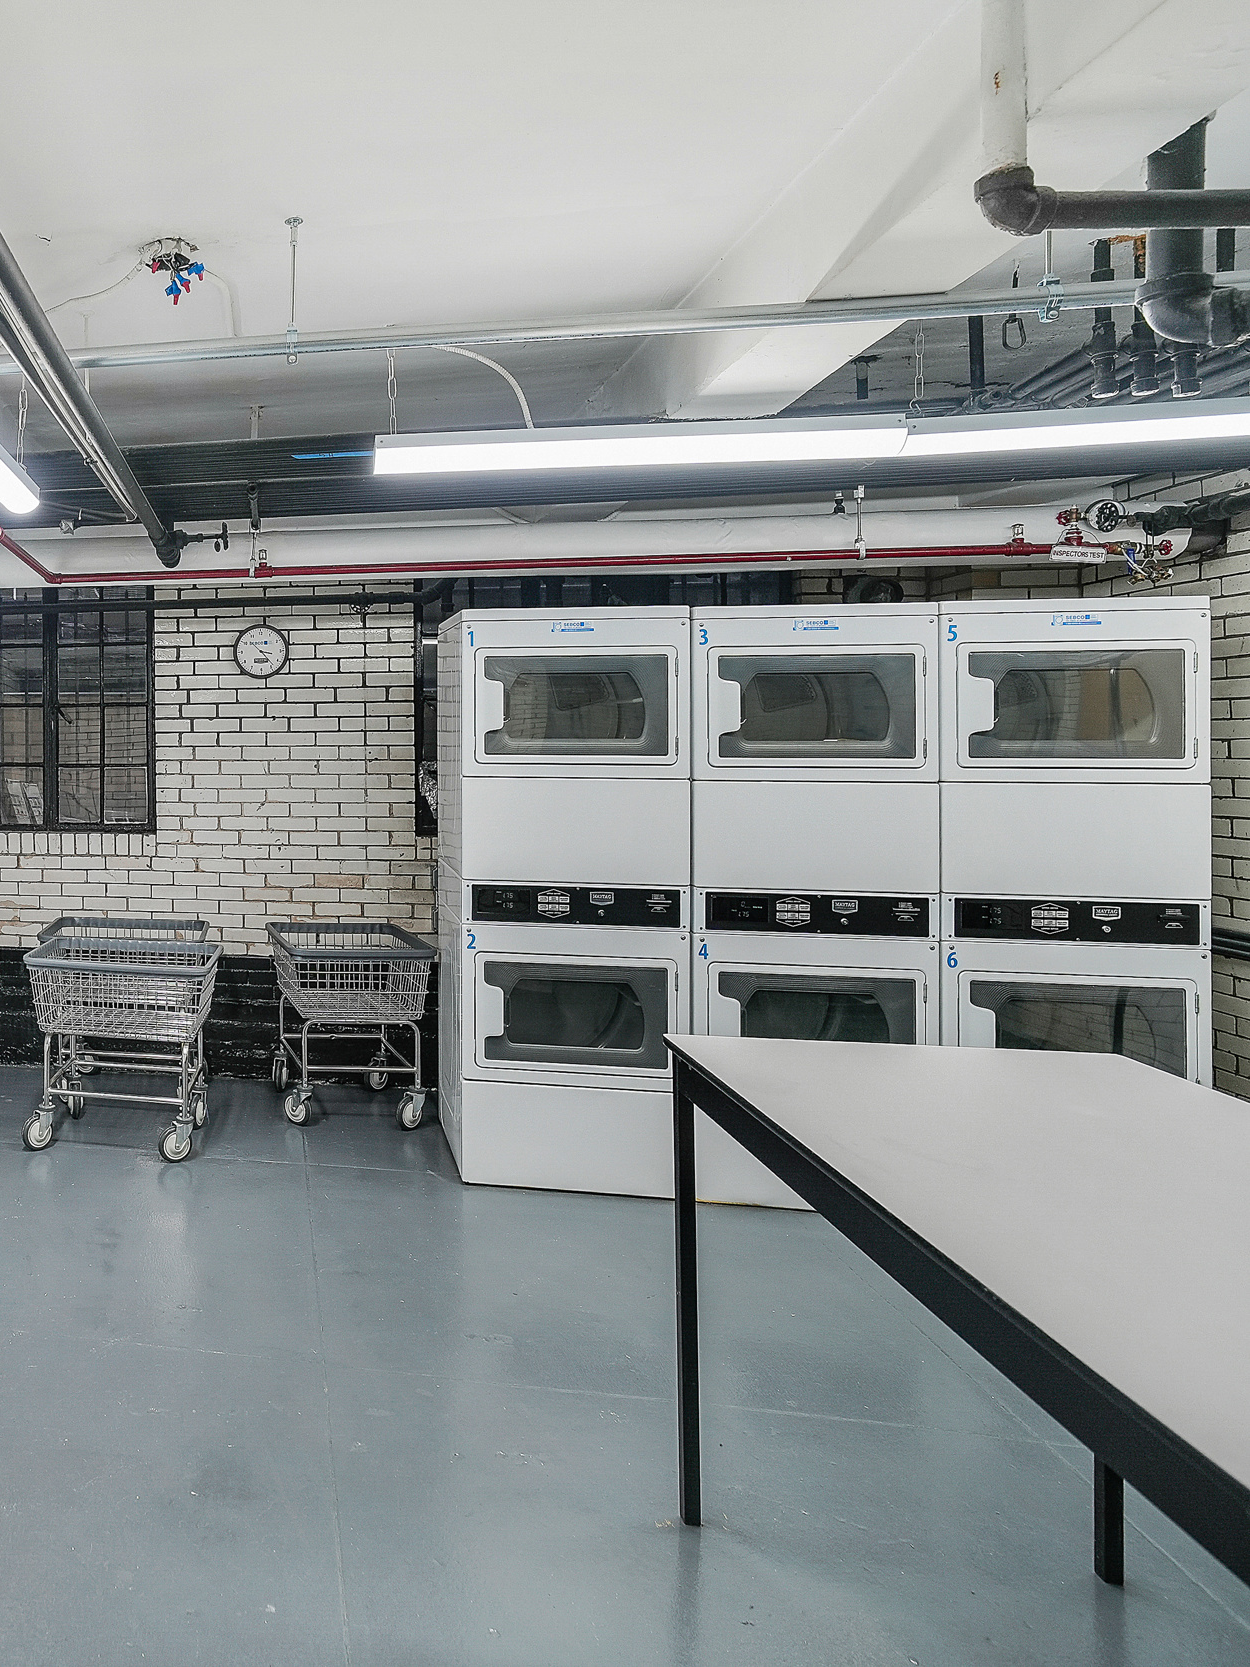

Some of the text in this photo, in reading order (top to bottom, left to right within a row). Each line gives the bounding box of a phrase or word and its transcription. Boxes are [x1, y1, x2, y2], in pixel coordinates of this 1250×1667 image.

[1089, 551, 1105, 559] TEST
[467, 631, 474, 647] 1
[699, 629, 709, 645] 3
[947, 624, 958, 642] 5
[467, 934, 476, 949] 2
[699, 944, 709, 959] 4
[947, 952, 958, 968] 6
